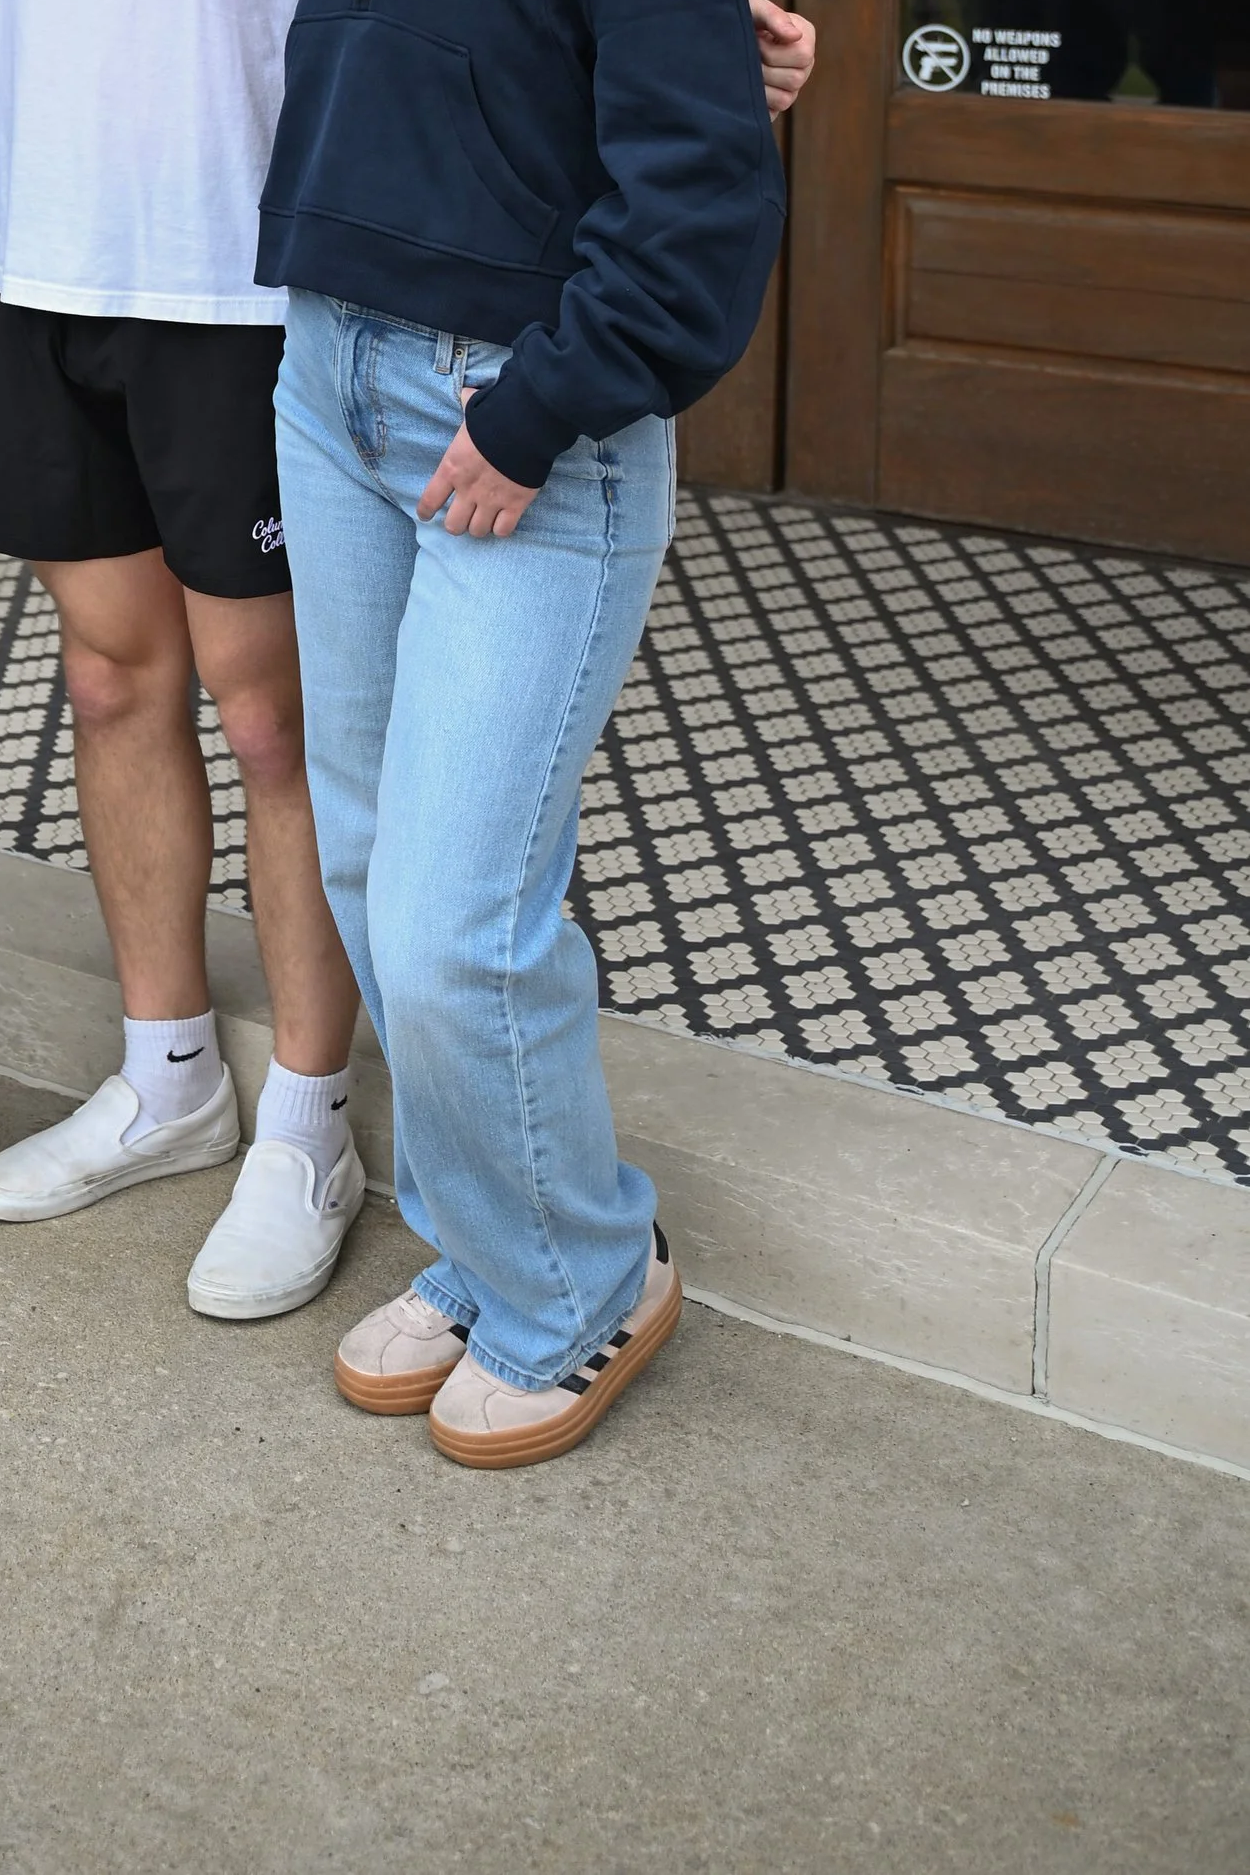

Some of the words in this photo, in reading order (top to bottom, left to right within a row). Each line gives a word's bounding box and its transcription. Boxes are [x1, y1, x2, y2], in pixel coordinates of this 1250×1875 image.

[972, 28, 993, 44] NO
[994, 29, 1062, 48] WEAPONS
[983, 46, 1050, 64] ALLOWED
[990, 63, 1011, 80] ON
[1013, 65, 1040, 81] THE
[980, 80, 1051, 100] PREMISES
